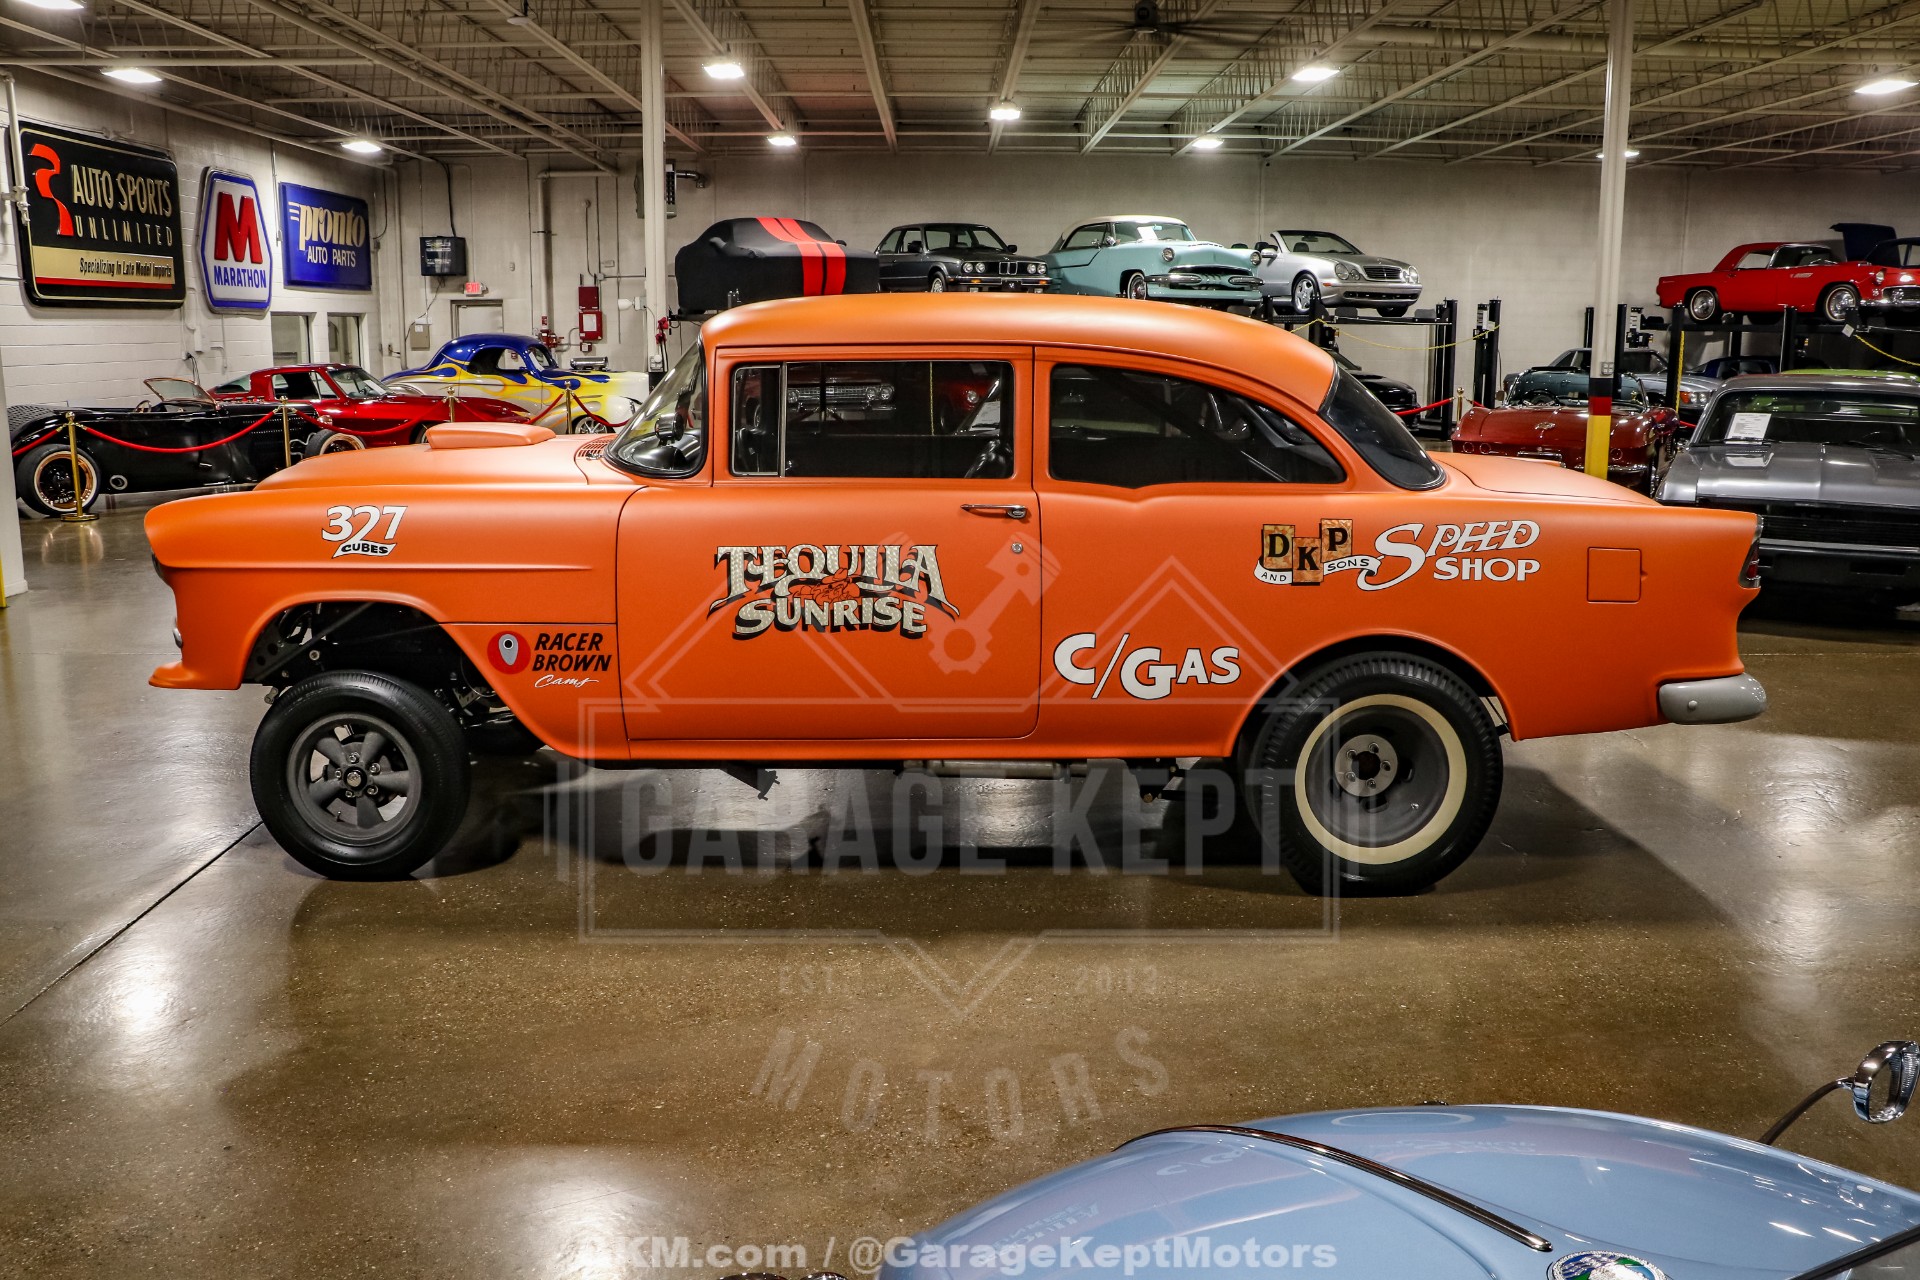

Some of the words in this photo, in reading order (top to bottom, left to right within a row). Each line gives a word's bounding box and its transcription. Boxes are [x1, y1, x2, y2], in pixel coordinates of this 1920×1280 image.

[71, 164, 113, 208] AUTO
[116, 174, 173, 217] SPORTS
[75, 214, 173, 247] UNLIMITED
[214, 191, 263, 264] M
[299, 203, 365, 251] pronto
[79, 257, 115, 277] Specializing
[122, 260, 135, 275] Late
[135, 261, 151, 277] Model
[307, 246, 328, 265] AUTO
[332, 250, 356, 268] PARTS
[214, 265, 266, 289] MARATHON
[465, 282, 480, 293] EXIT
[321, 505, 408, 543] 327
[340, 542, 388, 554] CUBES
[1261, 571, 1287, 582] AND
[1327, 558, 1370, 571] SONS
[1433, 556, 1541, 581] SHOP
[707, 543, 960, 622] TEQUILA
[732, 597, 928, 640] SUNRISE
[534, 632, 603, 651] RACER
[532, 653, 612, 672] BROWN
[534, 674, 600, 689] Cams
